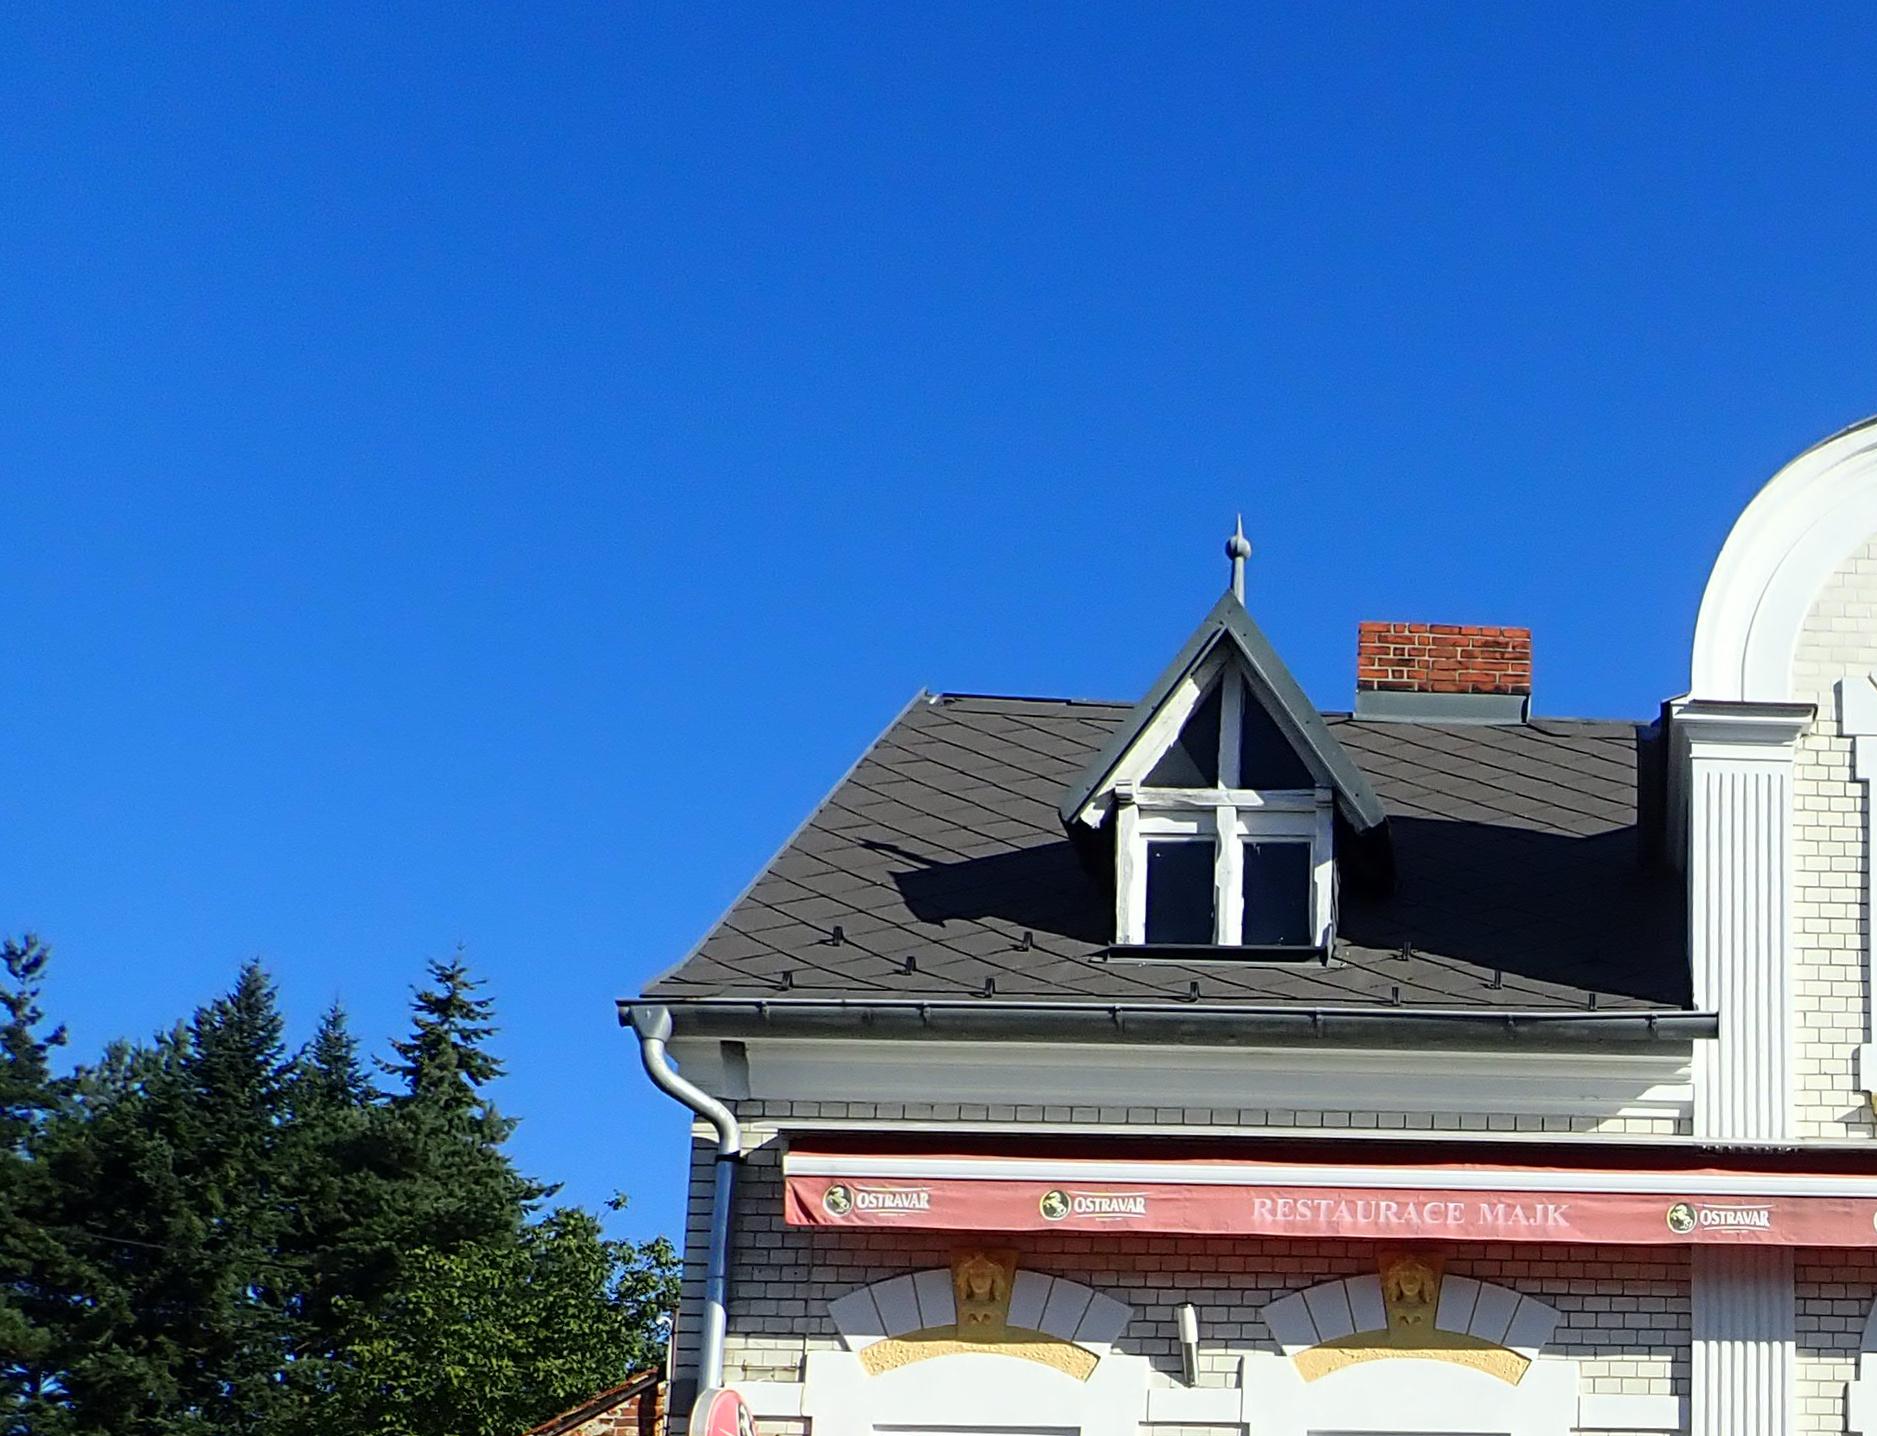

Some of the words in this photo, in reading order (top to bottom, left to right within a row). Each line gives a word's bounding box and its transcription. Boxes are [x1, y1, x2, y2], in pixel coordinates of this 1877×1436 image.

[856, 1191, 930, 1210] OSTRAVAR
[1074, 1196, 1146, 1215] OSTRAVAR
[1251, 1198, 1465, 1225] RESTAURACE
[1479, 1203, 1570, 1227] MAJK
[1699, 1209, 1771, 1227] OSTRAVAR
